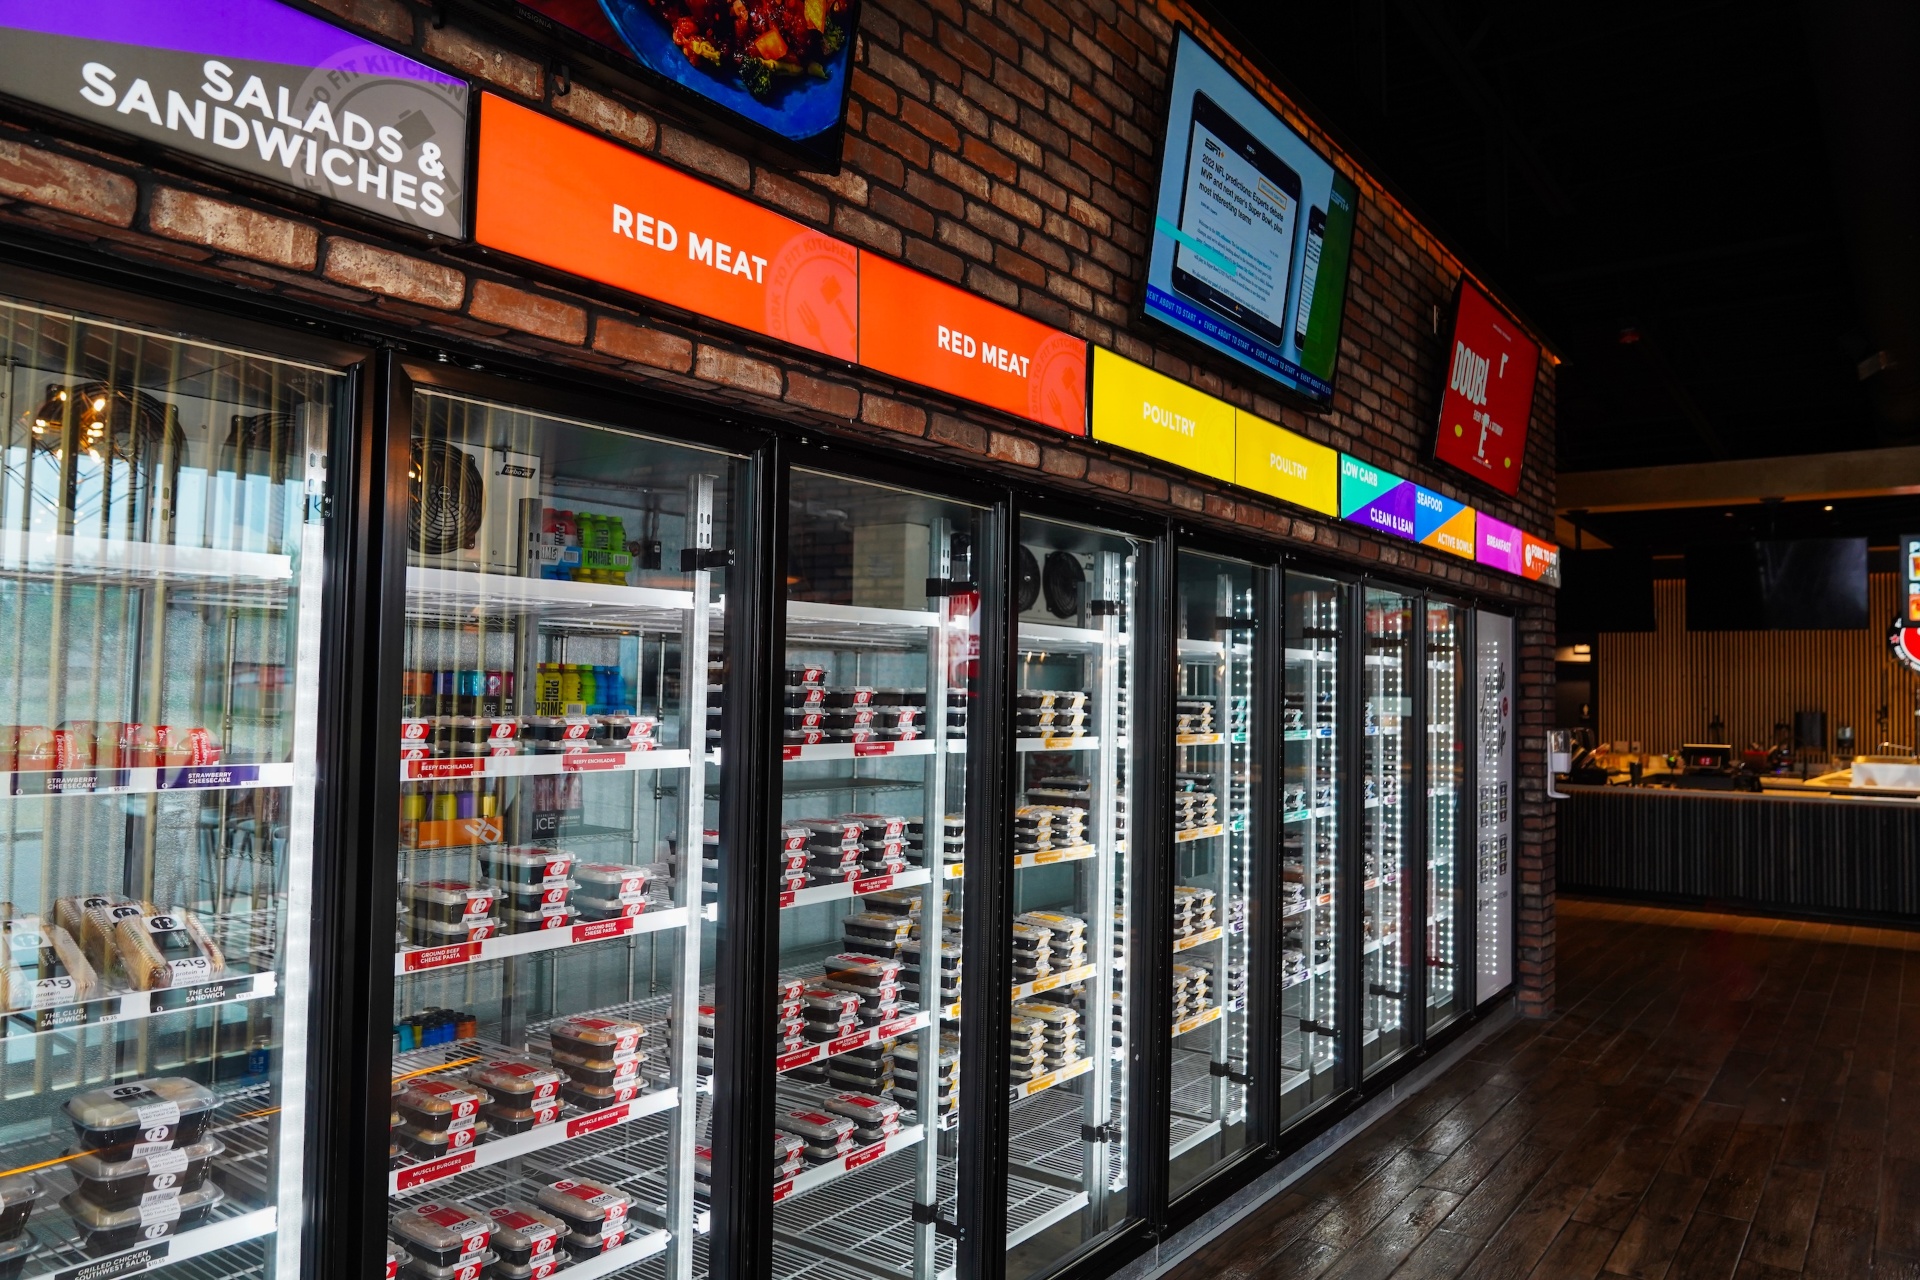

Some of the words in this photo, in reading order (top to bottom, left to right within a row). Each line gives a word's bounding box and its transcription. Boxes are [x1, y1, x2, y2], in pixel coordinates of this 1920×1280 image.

[518, 8, 552, 29] INSIGNIA
[326, 60, 361, 91] FIT
[364, 54, 465, 102] KITCHEN
[201, 59, 404, 163] SALADS
[418, 142, 446, 181] &
[79, 62, 445, 217] SANDWICHES
[1202, 153, 1214, 169] 2022
[1215, 162, 1225, 178] NFL
[1252, 192, 1270, 214] Experts
[1270, 205, 1284, 222] debate
[1198, 182, 1212, 197] most
[1212, 190, 1238, 216] interesting
[1238, 208, 1252, 226] teams
[1200, 166, 1213, 182] MVP
[1213, 178, 1222, 191] and
[1223, 183, 1234, 198] next
[1234, 191, 1248, 210] year's
[1248, 201, 1262, 219] Super
[1262, 212, 1274, 228] Bowl,
[1274, 222, 1283, 235] plus
[612, 203, 678, 252] RED
[688, 231, 768, 284] MEAT
[786, 249, 802, 268] FIT
[804, 237, 857, 266] KITCHEN
[938, 324, 976, 359] RED
[982, 342, 1030, 378] MEAT
[1158, 296, 1175, 312] ABOUT
[1175, 305, 1182, 315] TO
[1182, 308, 1197, 323] START
[1203, 320, 1218, 334] EVENT
[1218, 328, 1231, 342] ABOUT
[1232, 334, 1237, 344] TO
[1237, 338, 1250, 351] START
[1255, 348, 1268, 362] EVENT
[1268, 354, 1280, 368] ABOUT
[1280, 360, 1284, 370] TO
[1284, 362, 1296, 376] START
[1300, 374, 1310, 385] EVENT
[1310, 379, 1321, 390] ABOUT
[1450, 340, 1490, 406] DOUBL
[1142, 401, 1196, 438] POULTRY
[1270, 452, 1308, 480] POULTRY
[1342, 459, 1358, 478] LOW
[1359, 467, 1378, 487] CARB
[1416, 491, 1443, 513] SEAFOOD
[1370, 507, 1392, 527] CLEAN
[1392, 516, 1397, 529] &
[1398, 517, 1413, 535] LEAN
[1438, 532, 1455, 549] ACTIVE
[1456, 538, 1473, 554] BOWLS
[1486, 534, 1512, 553] BREAKFAST
[587, 550, 612, 566] PRIME
[1532, 560, 1557, 578] KITCHEN
[46, 776, 98, 785] STRAWBERRY
[47, 782, 97, 790] CHEESECAKE
[536, 817, 556, 830] ICE
[175, 959, 206, 968] 41g
[421, 950, 446, 958] GROUND
[35, 990, 61, 998] protein
[36, 979, 72, 988] 41g
[188, 989, 202, 997] THE
[204, 986, 223, 994] CLUB
[185, 991, 225, 1003] SANDWICH
[40, 1014, 87, 1027] SANDWICH
[62, 1008, 84, 1016] CLUB
[579, 1117, 598, 1127] MUSCLE
[598, 1111, 619, 1121] BURGERS
[412, 1166, 436, 1177] MUSCLE
[436, 1158, 462, 1170] BURGERS
[74, 1264, 124, 1280] SOUTHWEST
[125, 1255, 151, 1268] SALAD
[78, 1260, 112, 1276] GRILLED
[113, 1250, 149, 1265] CHICKEN
